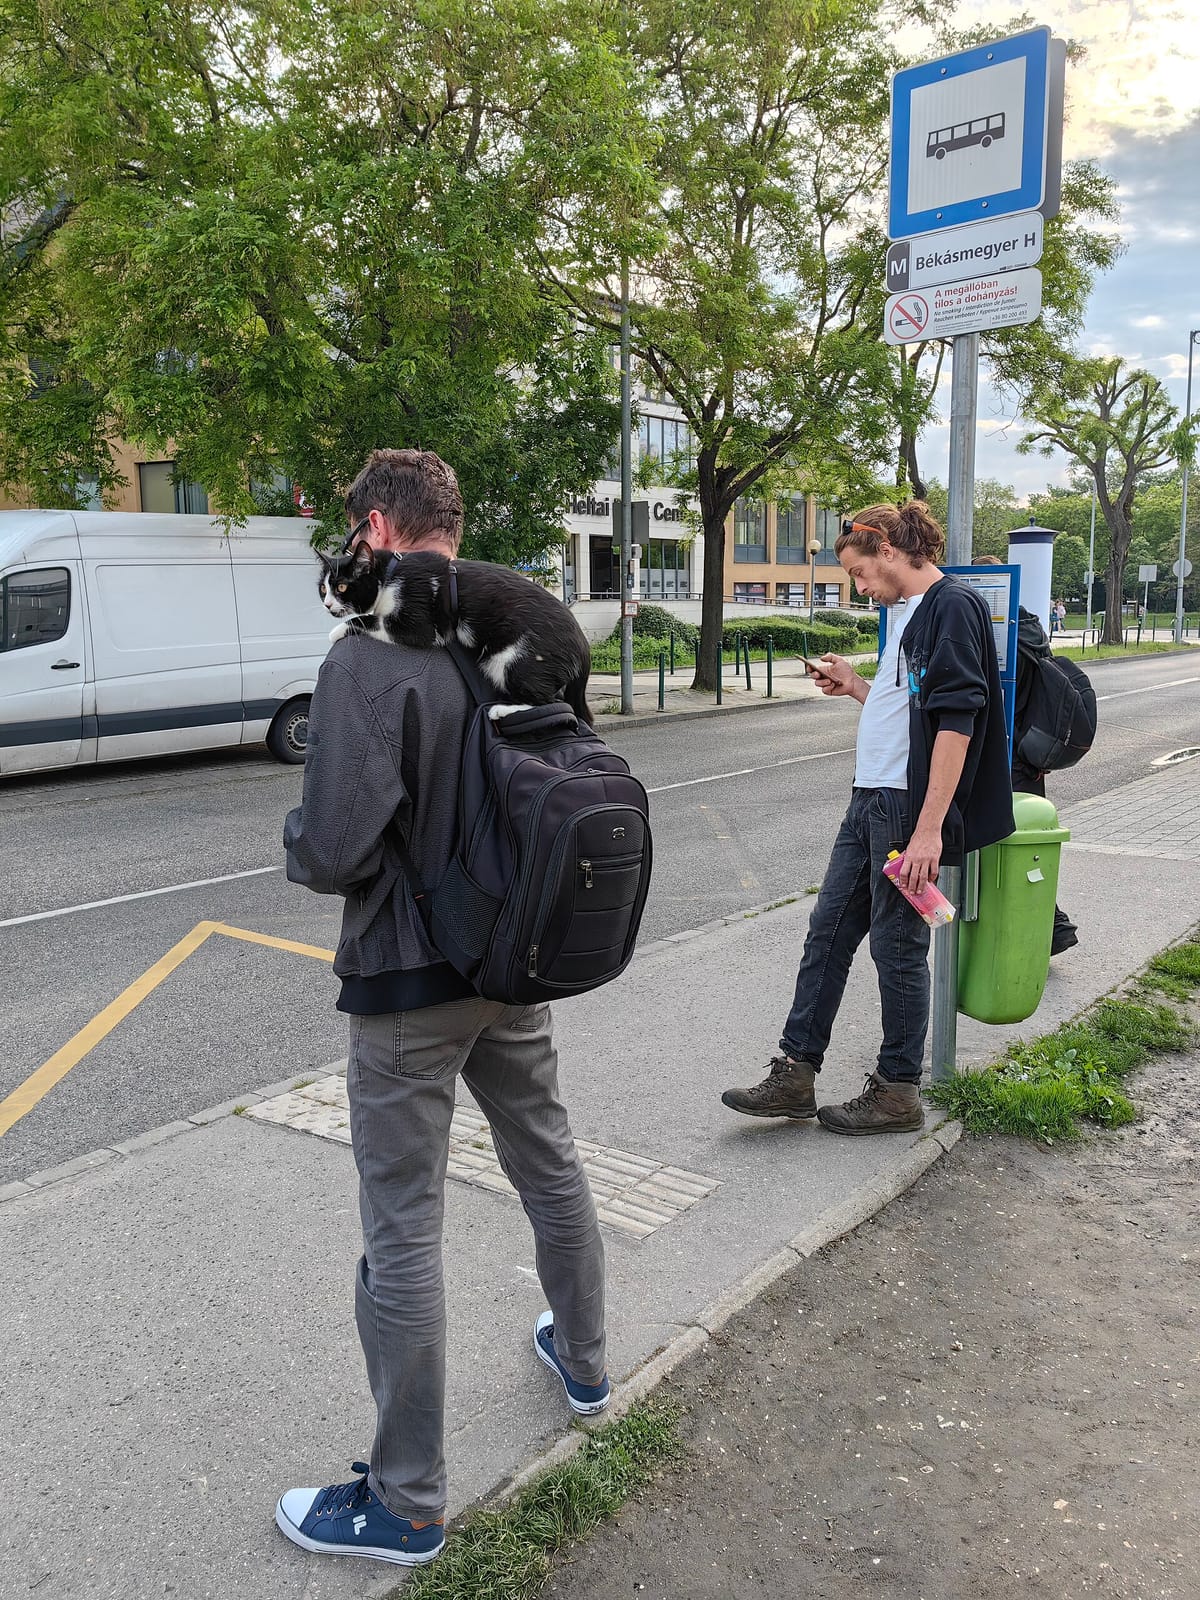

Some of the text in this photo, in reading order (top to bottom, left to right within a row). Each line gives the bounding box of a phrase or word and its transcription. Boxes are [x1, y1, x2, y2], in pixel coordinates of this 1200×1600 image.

[890, 258, 907, 276] M
[915, 238, 1019, 271] Békásmegyer
[1024, 232, 1036, 248] H
[935, 281, 998, 298] A megállóban
[935, 299, 953, 308] tilos
[965, 286, 1018, 303] dohányzás!
